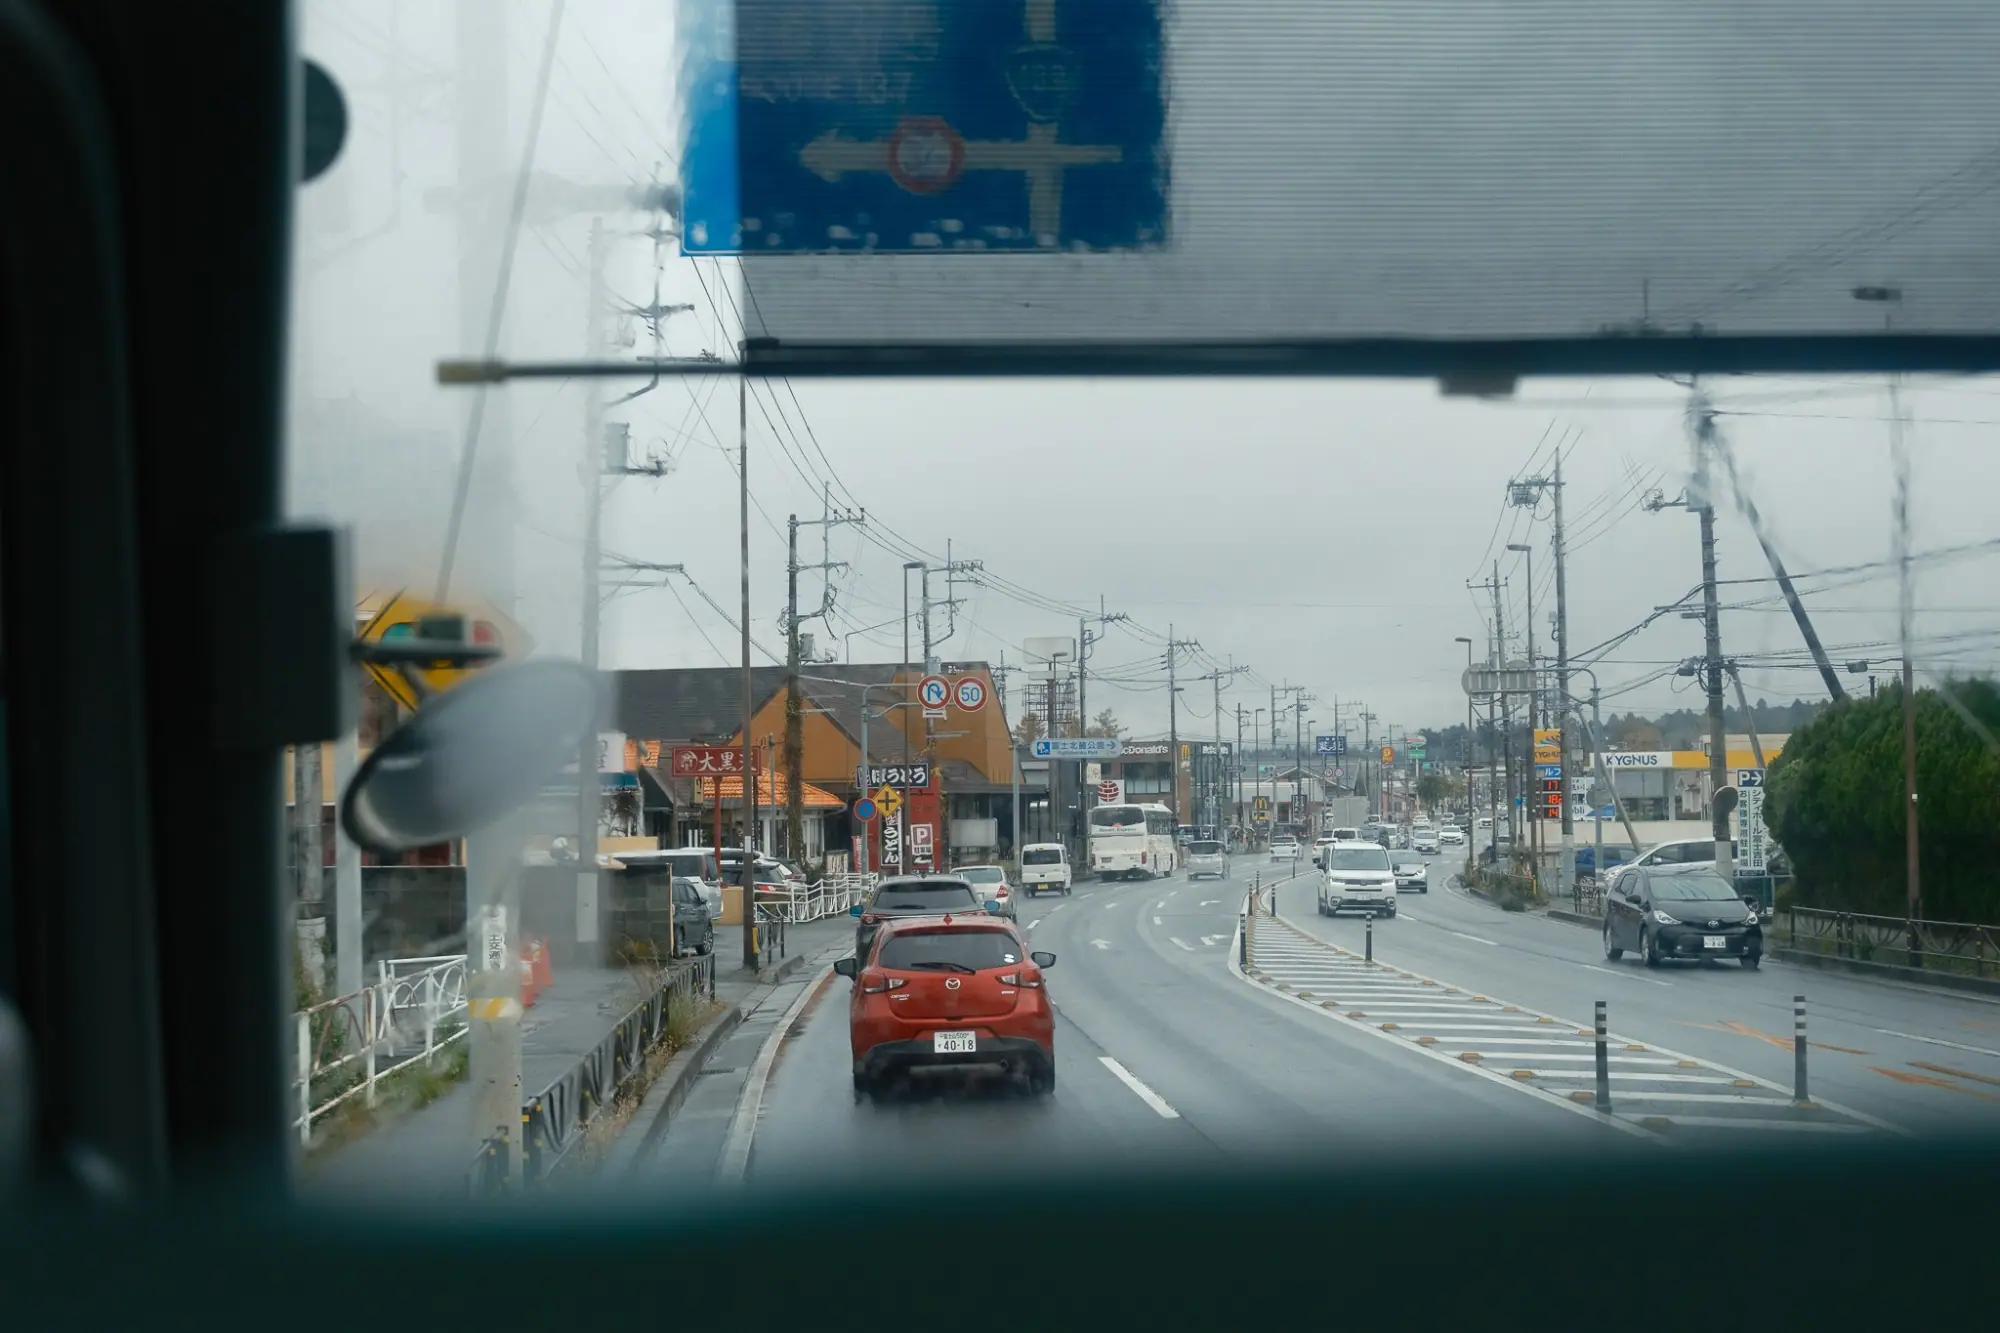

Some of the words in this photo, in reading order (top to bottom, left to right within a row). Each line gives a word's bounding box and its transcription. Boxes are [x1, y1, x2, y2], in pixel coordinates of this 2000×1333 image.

[961, 687, 980, 702] 50
[1121, 745, 1169, 755] cDonald's
[1606, 754, 1658, 766] KYGNUS
[1739, 771, 1750, 786] P
[916, 827, 929, 845] P
[944, 1039, 974, 1051] 40-18
